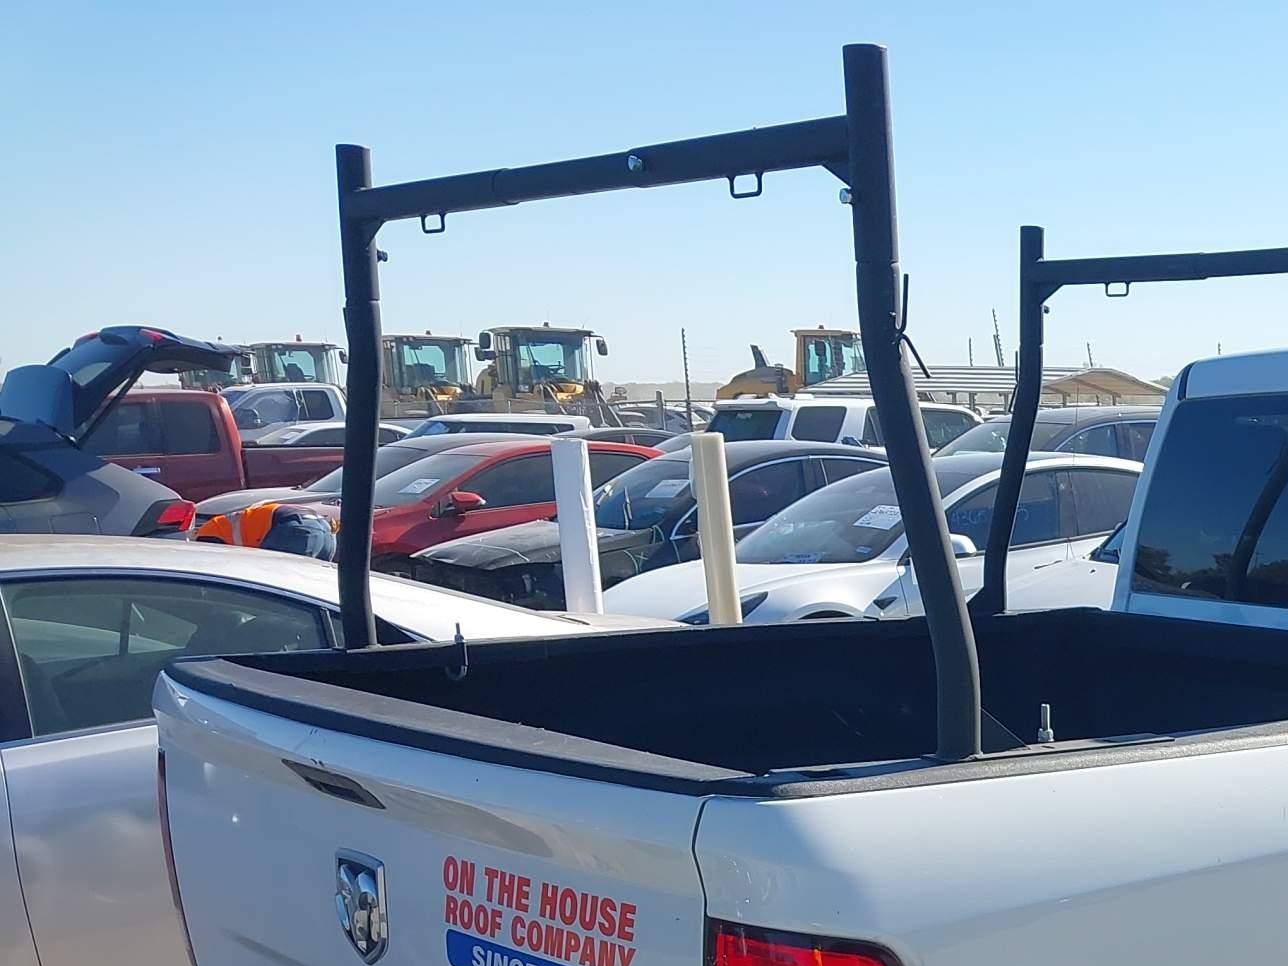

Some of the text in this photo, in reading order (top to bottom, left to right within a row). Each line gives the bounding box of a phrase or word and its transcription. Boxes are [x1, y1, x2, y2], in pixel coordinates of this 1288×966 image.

[443, 856, 637, 941] ON THE HOUSE
[445, 895, 502, 938] ROOF
